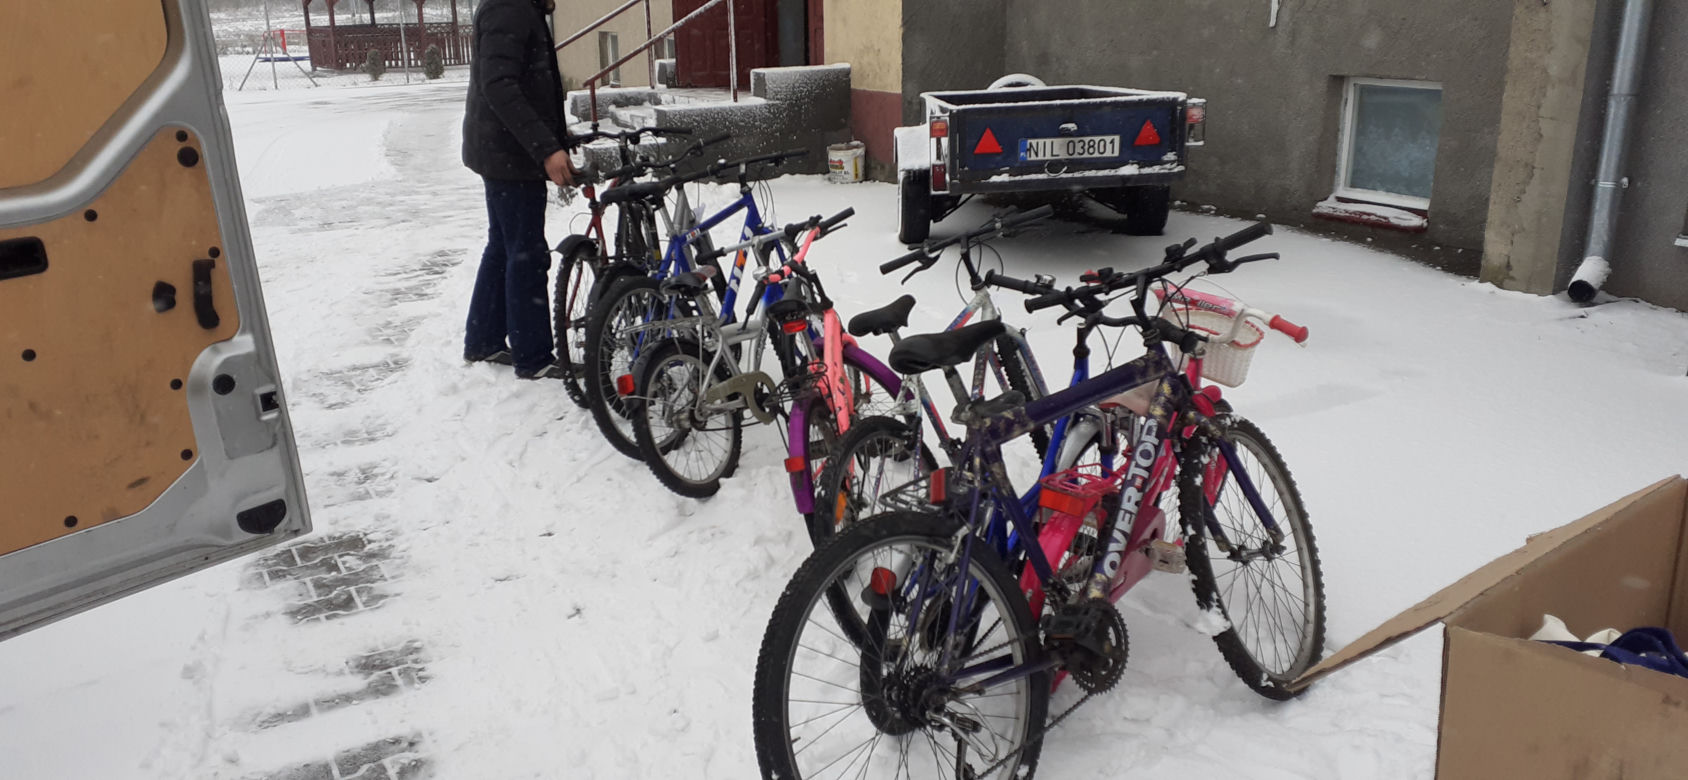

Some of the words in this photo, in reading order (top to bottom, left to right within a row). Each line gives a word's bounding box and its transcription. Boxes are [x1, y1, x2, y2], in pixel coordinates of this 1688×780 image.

[1028, 141, 1060, 158] NIL
[1066, 137, 1116, 157] 03801
[1103, 486, 1143, 579] OVER
[1128, 418, 1160, 480] TOP
